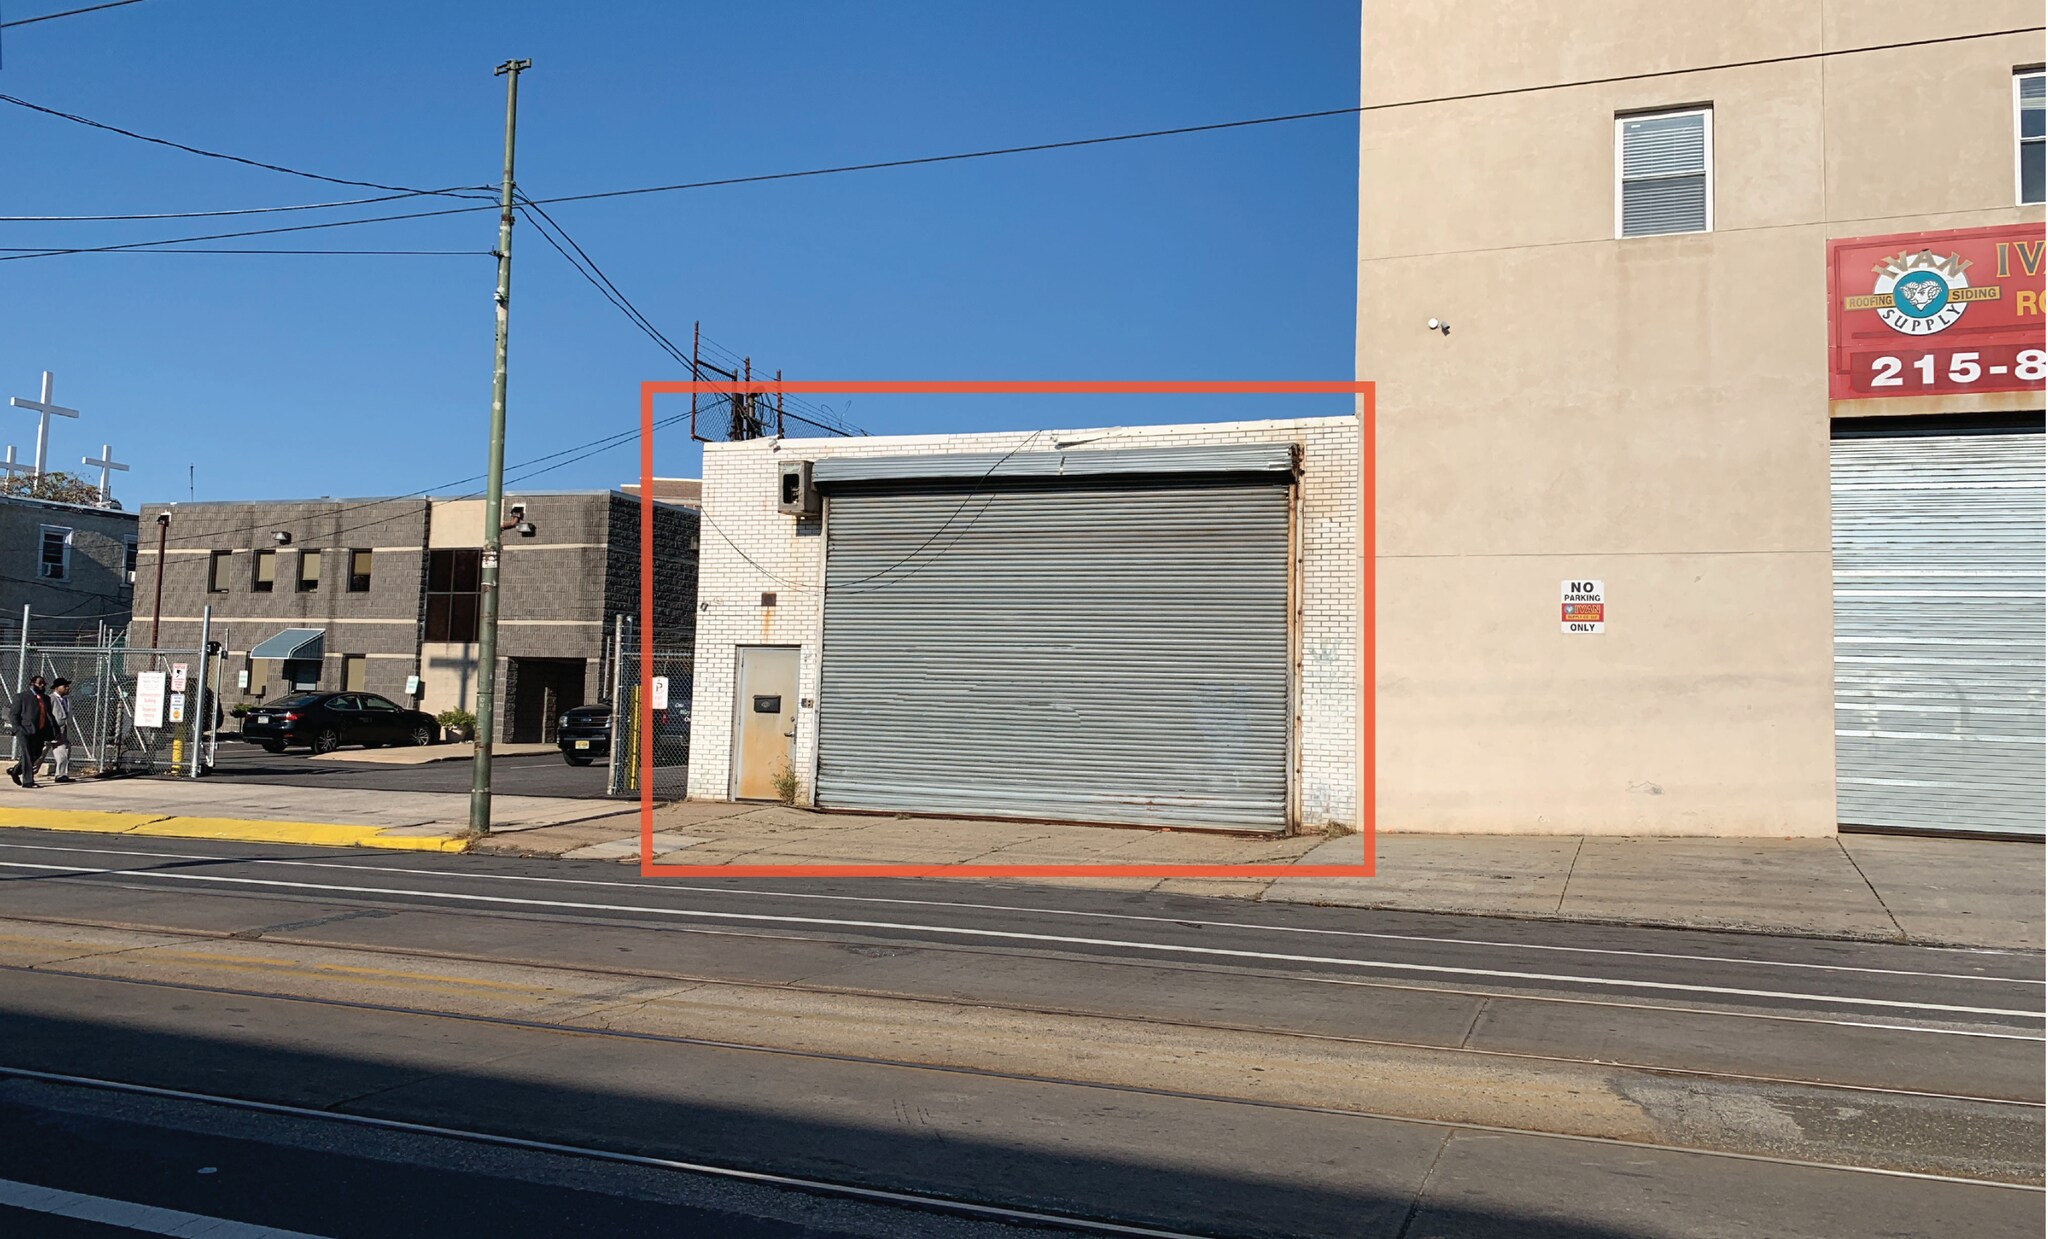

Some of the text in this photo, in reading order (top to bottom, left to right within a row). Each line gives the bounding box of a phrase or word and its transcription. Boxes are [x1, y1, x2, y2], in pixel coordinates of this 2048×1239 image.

[1871, 249, 1974, 281] IVAN
[1995, 240, 2046, 278] IV
[1952, 287, 1997, 301] SIDING
[1849, 295, 1893, 308] ROOFING
[1882, 303, 1961, 332] SUPPLY
[1870, 349, 2046, 387] 215-8
[1571, 582, 1594, 593] NO
[1564, 594, 1601, 602] PARKING
[1574, 604, 1600, 613] IVAN
[1570, 623, 1595, 632] ONLY
